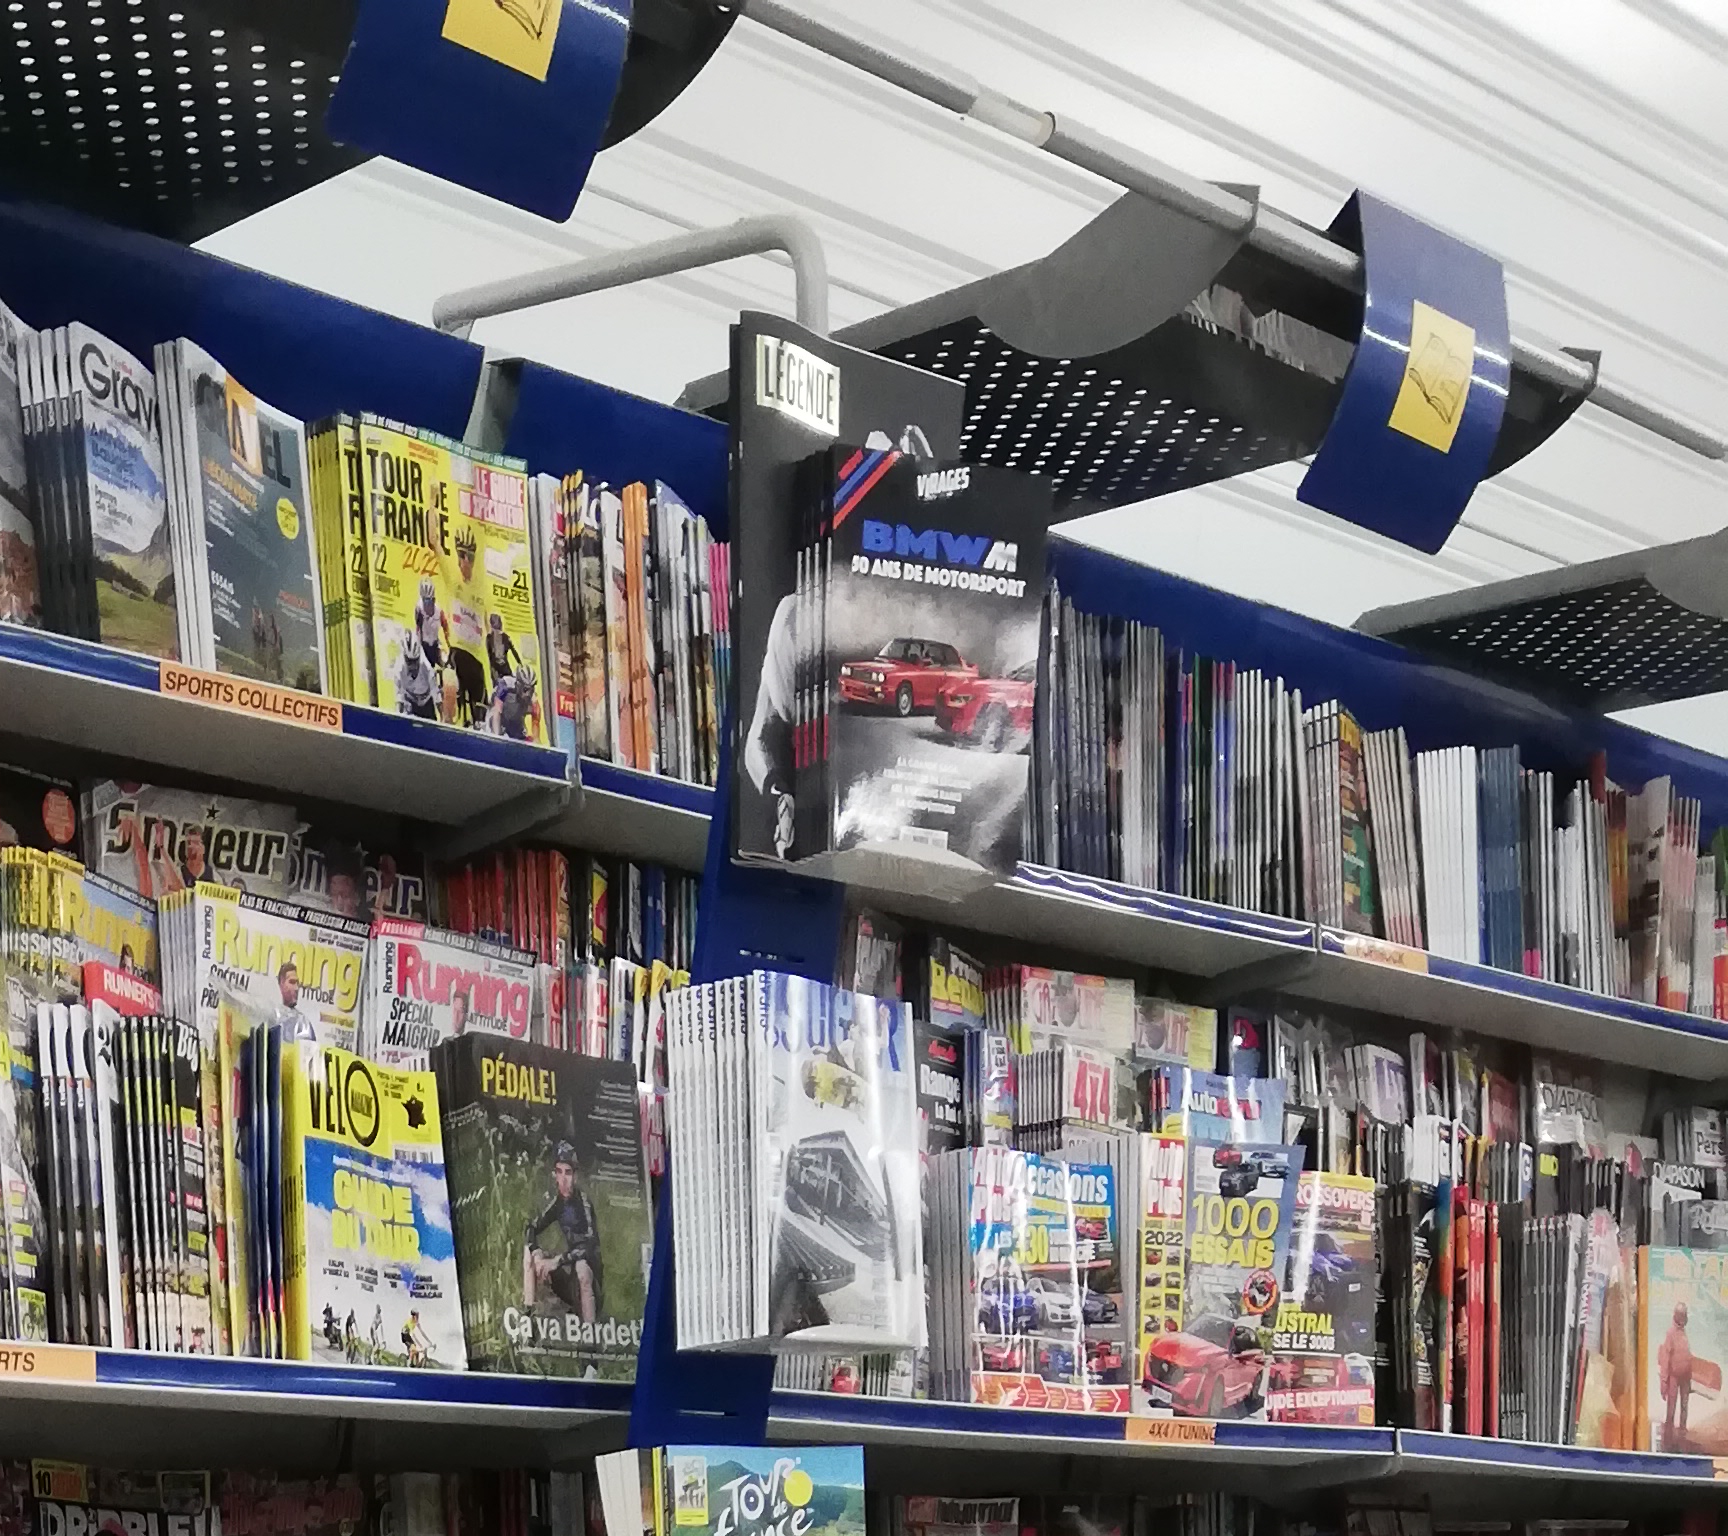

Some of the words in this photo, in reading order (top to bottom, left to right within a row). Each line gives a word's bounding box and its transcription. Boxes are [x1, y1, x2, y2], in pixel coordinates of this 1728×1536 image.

[763, 341, 836, 428] LÉGENDE
[917, 467, 971, 499] VIRAGES
[513, 570, 528, 590] 21
[851, 554, 870, 572] 50
[872, 558, 901, 580] ANS
[903, 563, 923, 583] DE
[925, 566, 1025, 598] MOTORSPORT
[164, 671, 233, 706] SPORTS
[236, 682, 340, 728] COLLECTIFS
[214, 911, 363, 1012] Running
[397, 943, 531, 1038] Running
[390, 998, 434, 1026] SPÉCIAL
[1654, 1161, 1705, 1189] DIAPASON
[1192, 1194, 1279, 1239] 1000
[1145, 1231, 1183, 1245] 2022
[1190, 1233, 1275, 1269] ESSAIS
